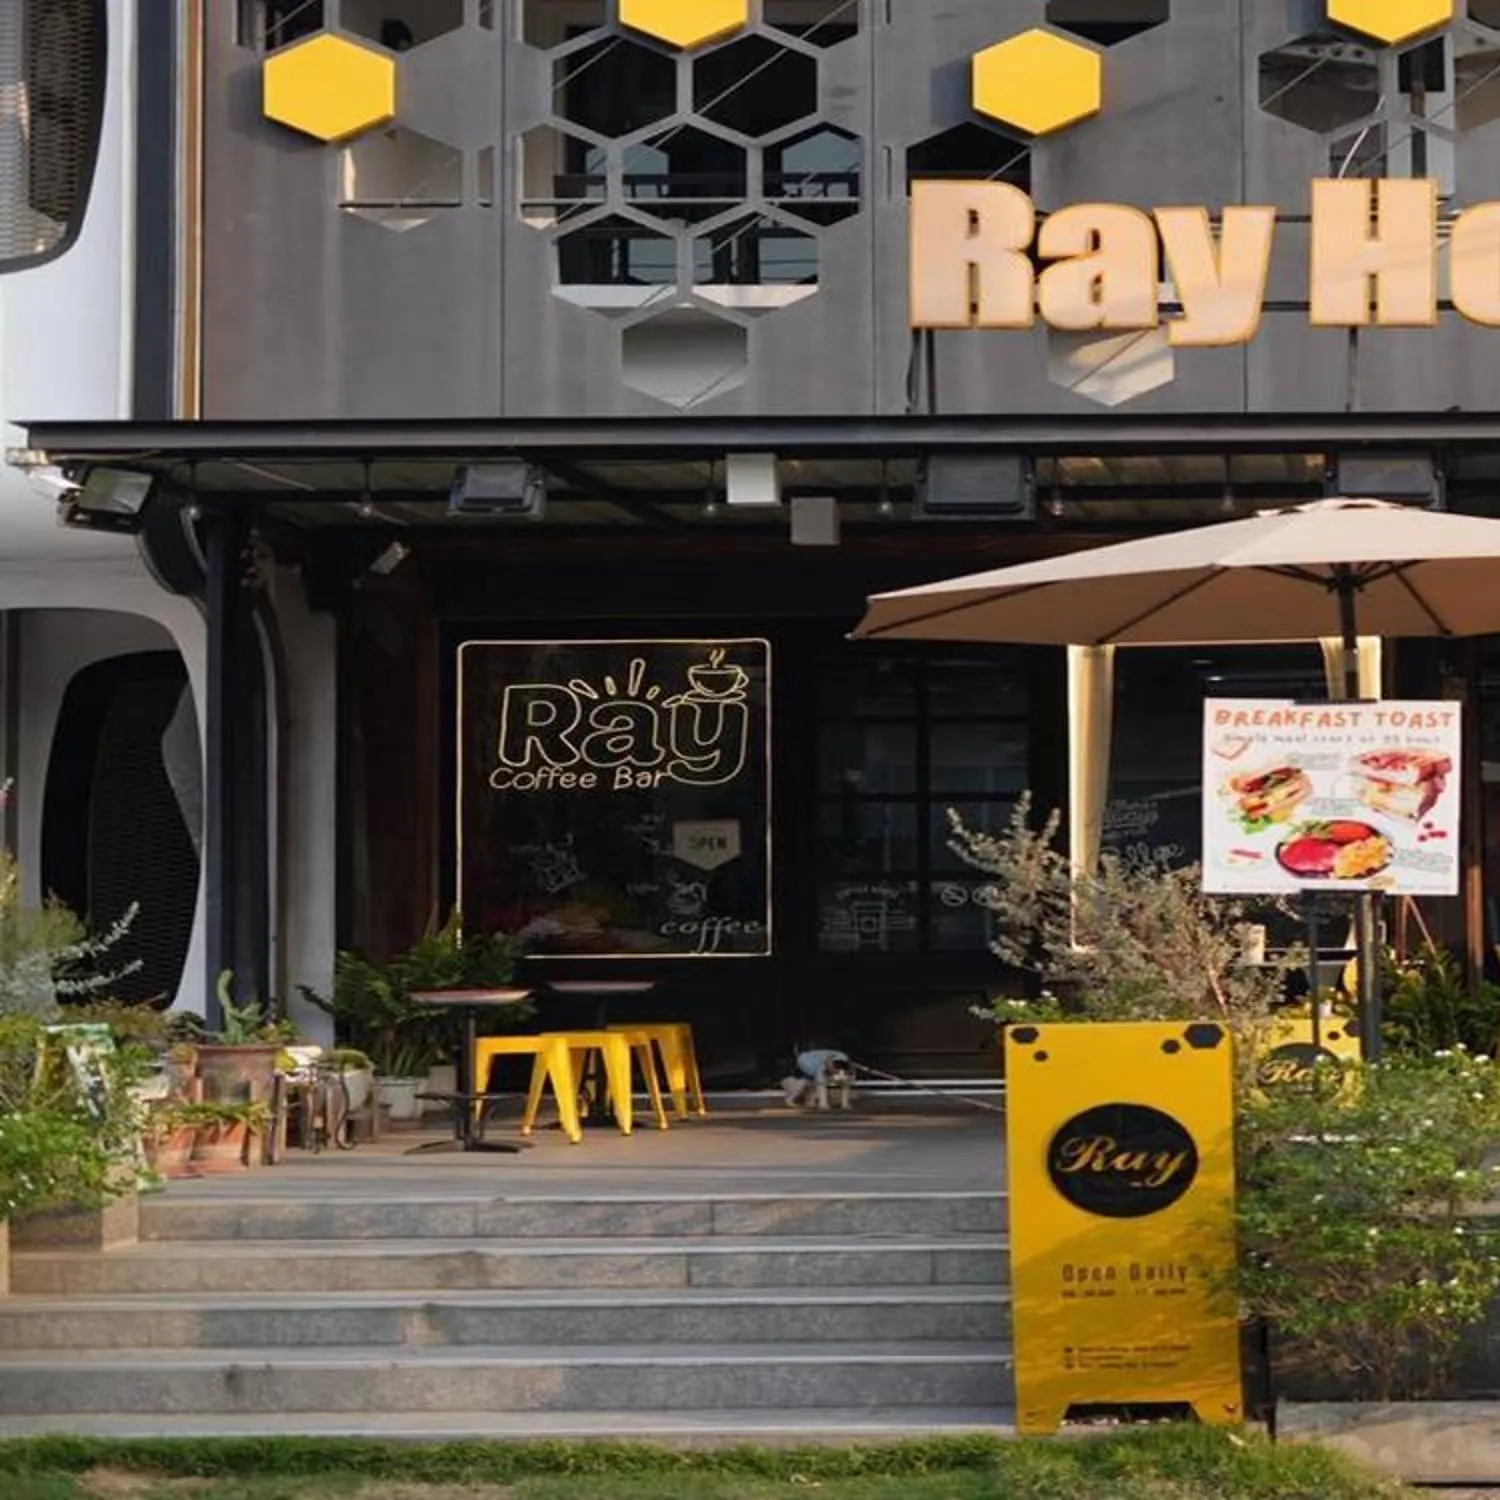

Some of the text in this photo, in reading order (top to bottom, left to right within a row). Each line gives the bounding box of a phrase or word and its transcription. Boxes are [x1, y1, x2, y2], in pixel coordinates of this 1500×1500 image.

[908, 178, 1276, 347] Ray
[498, 683, 749, 784] Ray
[1214, 708, 1455, 728] BREAKFAST TOAST
[489, 766, 668, 791] Coffee Bar
[660, 916, 766, 953] coffee
[1056, 1135, 1187, 1188] Ray
[1130, 1261, 1188, 1283] Daily
